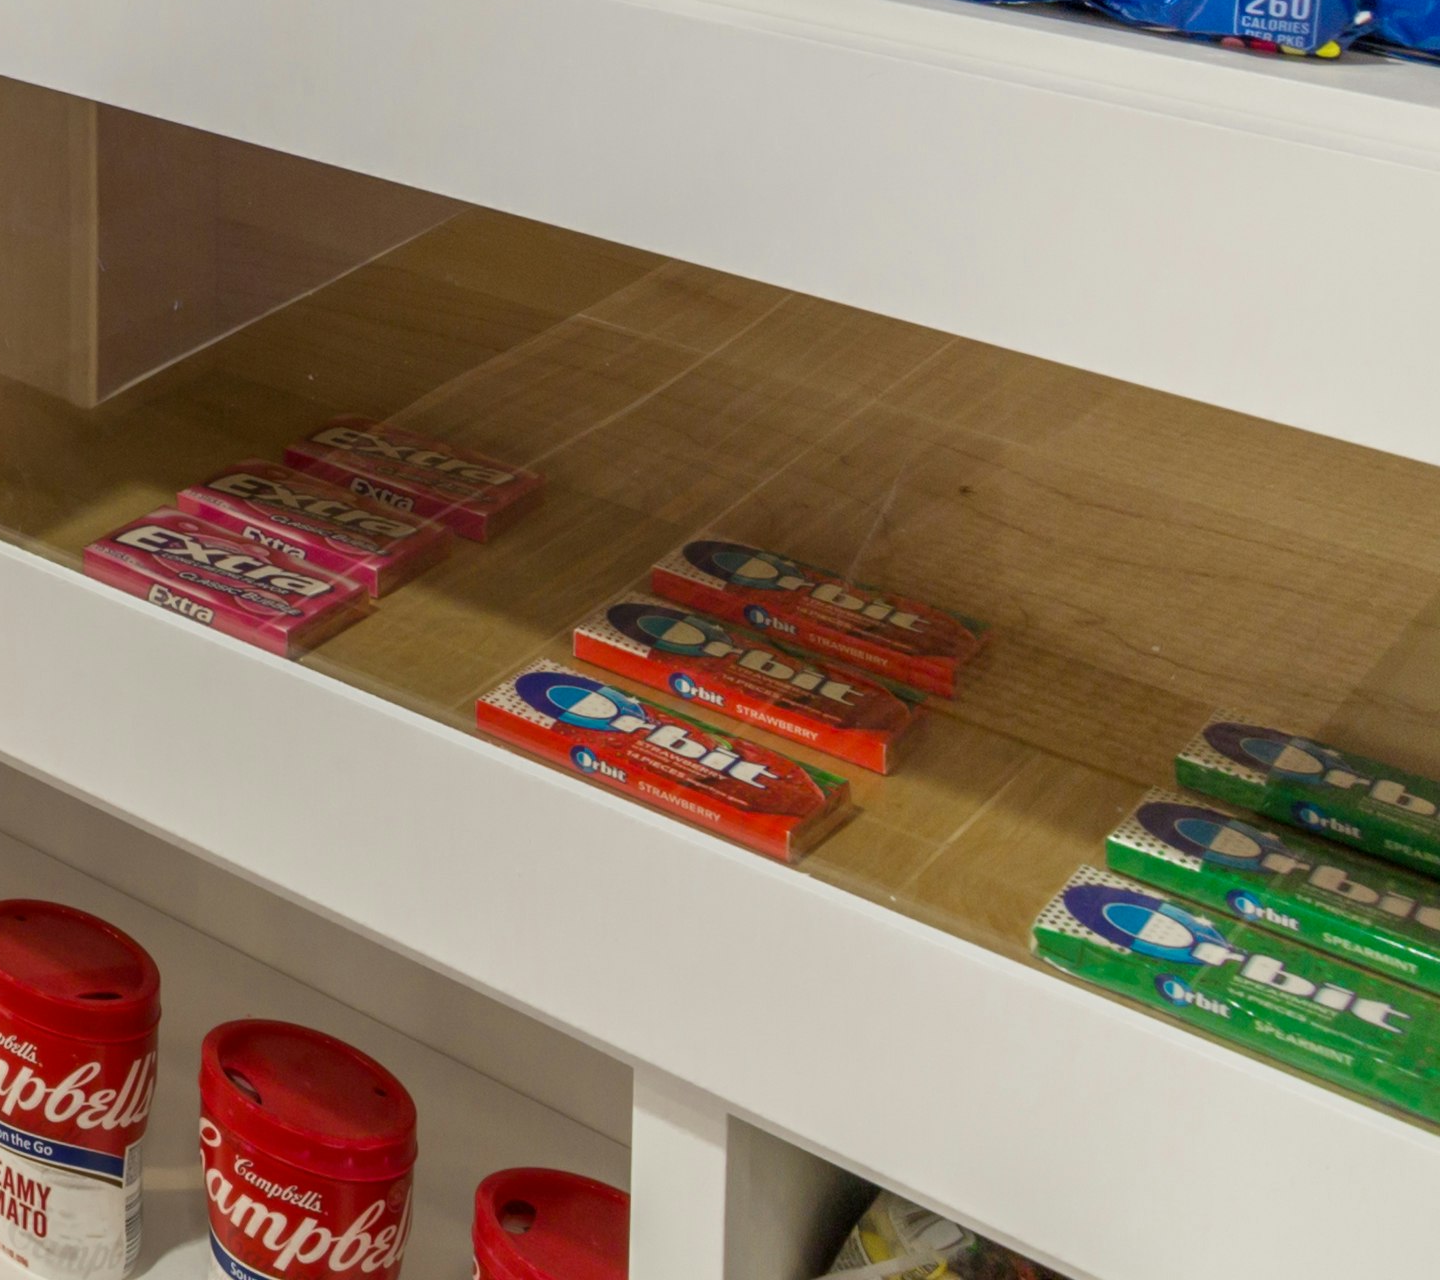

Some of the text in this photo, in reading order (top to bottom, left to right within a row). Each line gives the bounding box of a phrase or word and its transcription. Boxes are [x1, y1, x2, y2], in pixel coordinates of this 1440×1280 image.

[1241, 15, 1310, 34] CALORIES
[312, 426, 517, 486] Extra
[206, 472, 419, 538] Extra
[350, 477, 416, 513] Extra
[114, 525, 335, 597] Extra
[179, 570, 240, 597] CLASSIC
[682, 540, 932, 633] Orbit
[148, 583, 216, 624] Extra
[743, 603, 889, 667] Orbit STRAWBERRY
[607, 602, 865, 706] Orbit
[514, 671, 782, 790] Orbit
[668, 671, 819, 741] Orbit STRAWBERRY
[571, 744, 721, 823] Orbit STRAWBERRY
[1291, 800, 1362, 839] Orbit
[1063, 885, 1412, 1034] Orbit
[1226, 889, 1419, 974] Orbit SPEARMINT
[1154, 973, 1355, 1066] Orbit SPEARMINT
[11, 1132, 30, 1151] the
[33, 1138, 53, 1156] Go
[234, 1156, 323, 1215] Campbell's
